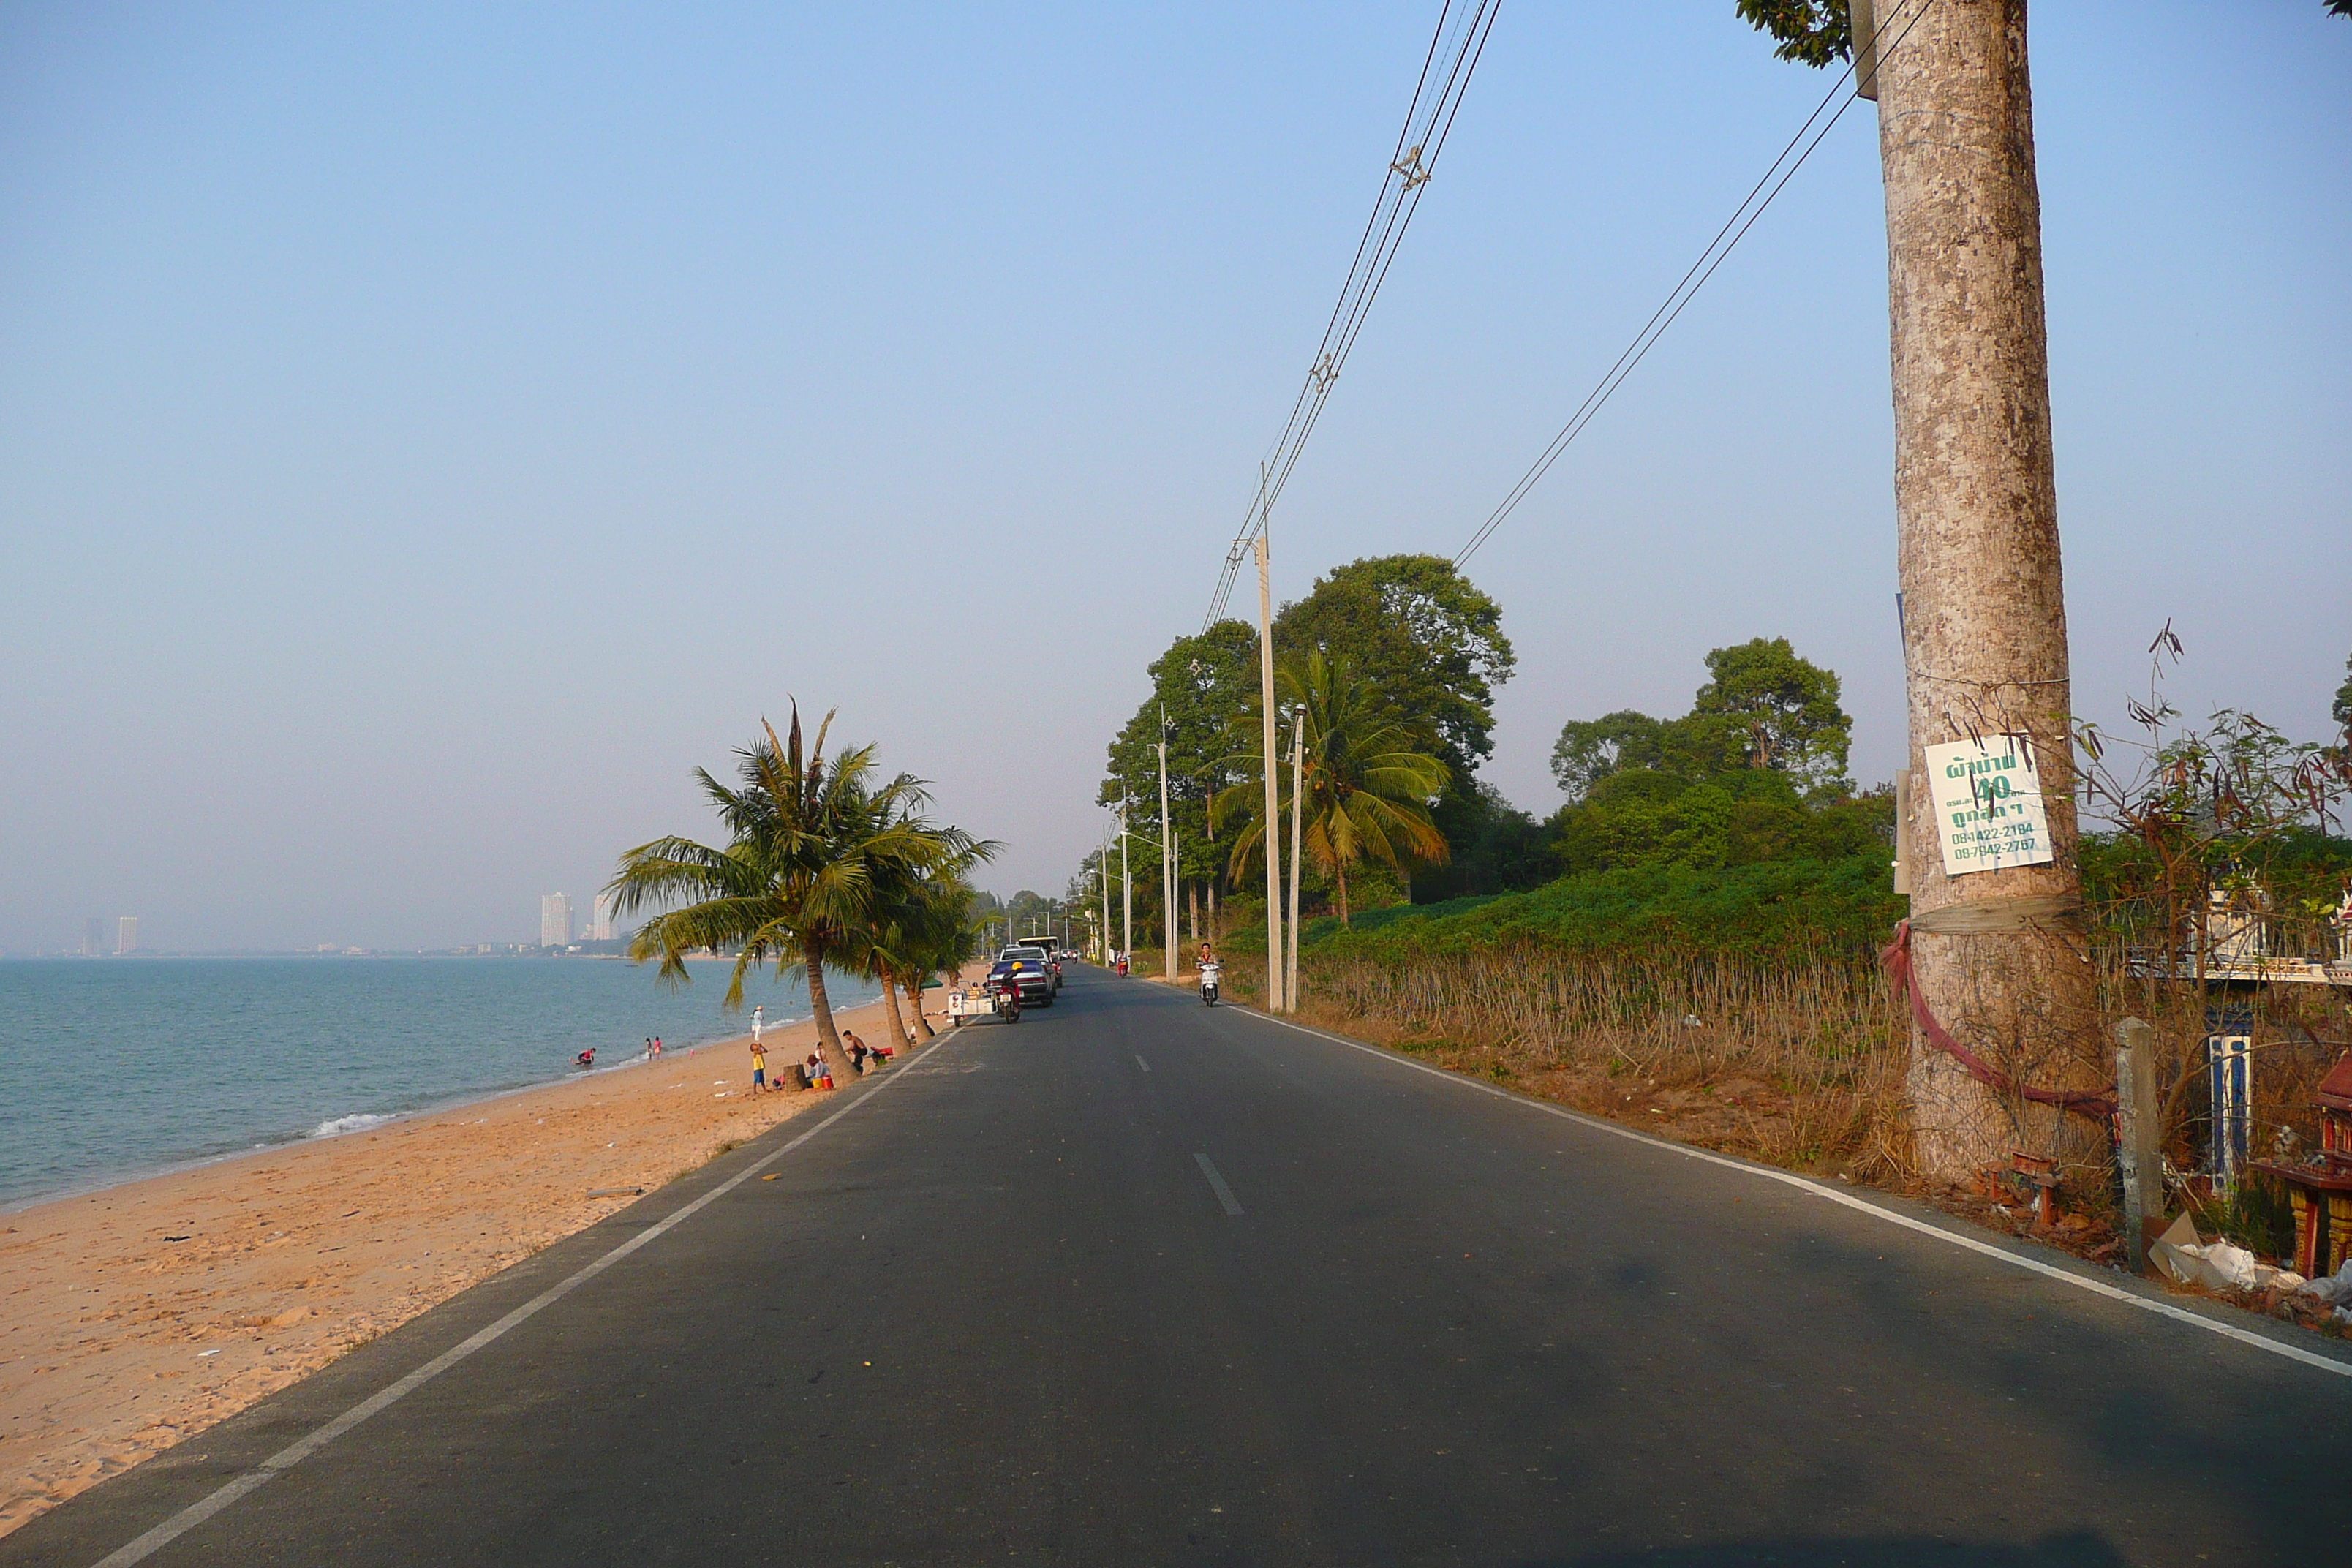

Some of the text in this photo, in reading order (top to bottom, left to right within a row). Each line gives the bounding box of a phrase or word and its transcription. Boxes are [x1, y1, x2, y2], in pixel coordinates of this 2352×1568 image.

[1946, 753, 2017, 779] ผ้าม่าน
[1977, 775, 2010, 800] 40
[1952, 823, 2033, 845] 08-1422-2184
[1954, 838, 2035, 859] 08-7942-2767
